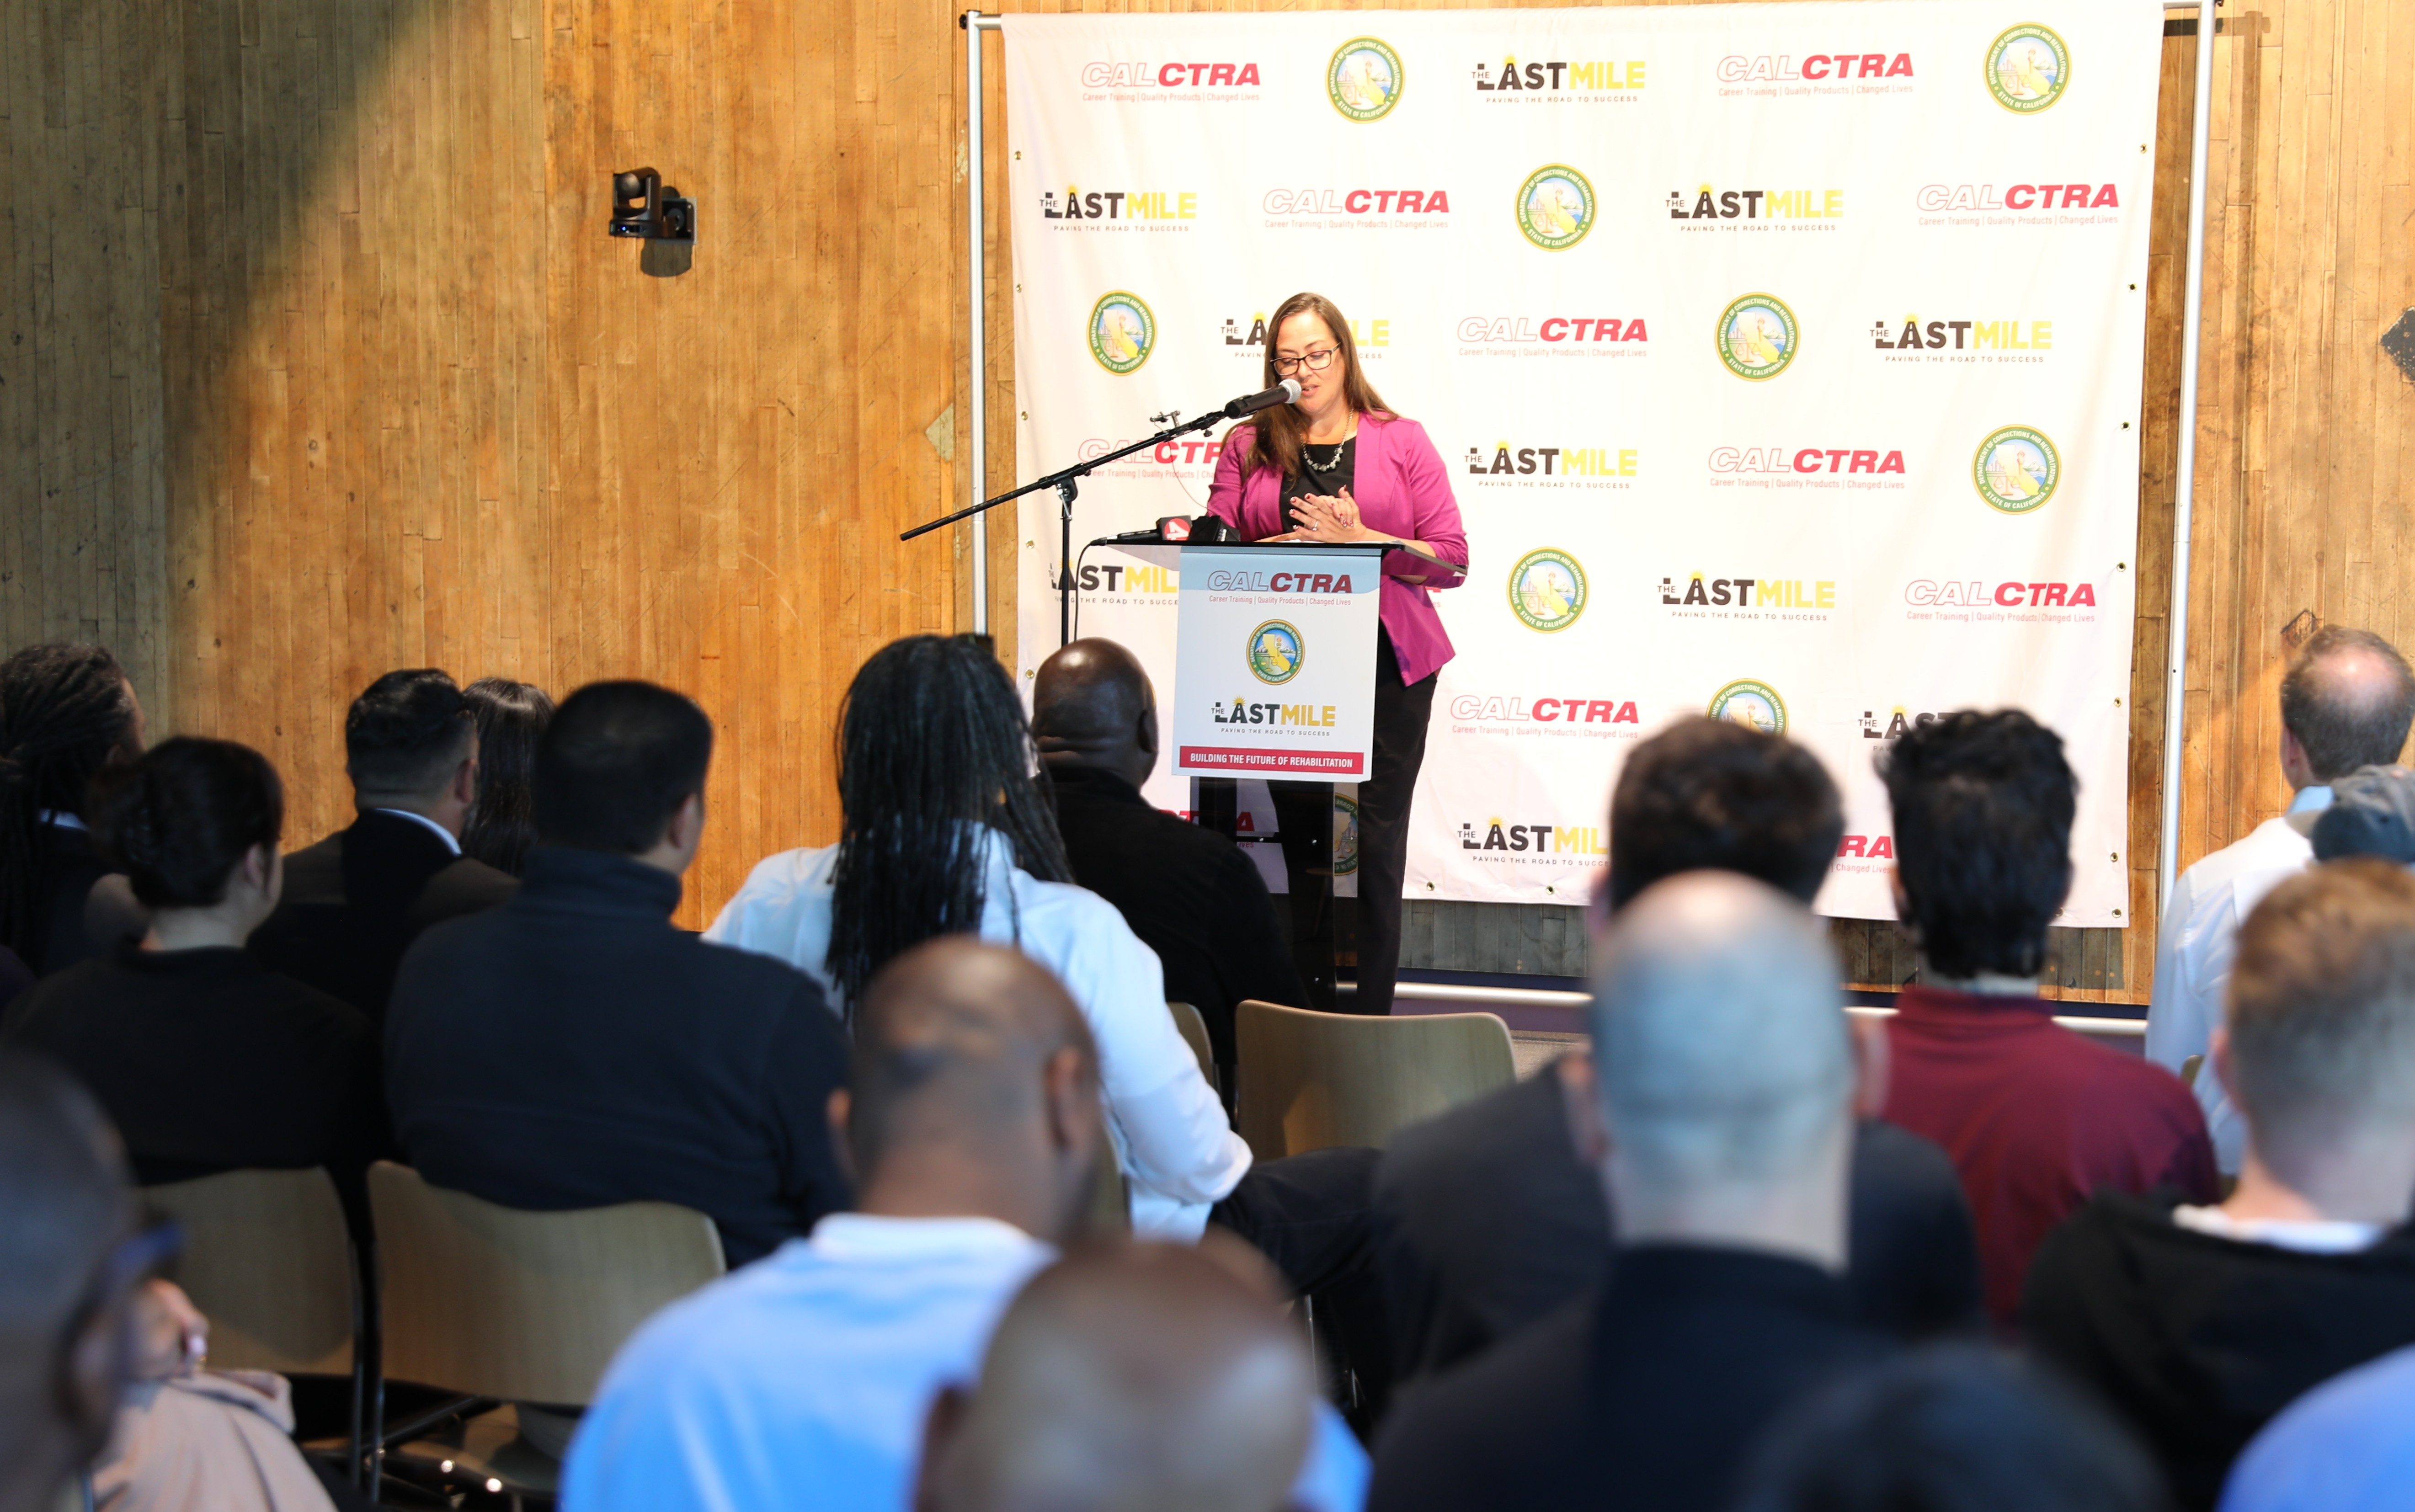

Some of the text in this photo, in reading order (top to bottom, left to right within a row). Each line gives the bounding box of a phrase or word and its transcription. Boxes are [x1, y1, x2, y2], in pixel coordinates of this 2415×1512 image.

[1081, 62, 1261, 87] CALCTRA
[1717, 53, 1914, 82] CALCTRA
[1718, 84, 1913, 98] Career Training Quality Products Changed Lives
[1264, 189, 1450, 214] CALCTRA
[1917, 184, 2119, 211] CALCTRA
[1291, 219, 1322, 229] Training
[1329, 220, 1354, 229] Quality
[1357, 220, 1388, 228] Products
[1395, 220, 1427, 229] Changed
[1919, 215, 2119, 227] Career Training Quality Products Changed Lives
[1458, 317, 1648, 342] CALCTRA
[1486, 347, 1516, 358] Training
[1523, 348, 1549, 357] Quality
[1552, 348, 1585, 356] Products
[1592, 349, 1626, 358] Changed
[1709, 447, 1906, 474] CALCTRA
[1977, 431, 2056, 485] DEPARTMENT OF CORRECTIONS AND REHABILITATION
[1108, 469, 1136, 479] Training
[1142, 470, 1163, 479] Quality
[1710, 478, 1735, 486] Career
[1738, 479, 1770, 489] Training
[1776, 479, 1803, 489] Quality
[1806, 479, 1839, 488] Products
[1847, 480, 1882, 490] Changed
[1986, 491, 2002, 506] STATE
[2012, 491, 2046, 509] CALIFORNIA
[1208, 570, 1353, 593] CALCTRA
[1512, 568, 1523, 604] DEPARTMENT
[1526, 553, 1561, 564] CORRECTIONS
[1560, 556, 1571, 565] AND
[1569, 564, 1584, 605] REHABILITATION
[1229, 596, 1253, 604] Training
[1258, 596, 1278, 605] Quality
[1309, 598, 1334, 606] Changed
[1905, 580, 2096, 607] CALCTRA
[1520, 611, 1535, 624] STATE
[1544, 612, 1574, 628] CALIFORNIA
[1907, 611, 1933, 620] Career
[1935, 612, 1969, 622] Training
[1977, 612, 2005, 622] Quality
[2008, 613, 2037, 622] Products
[2041, 613, 2071, 623] Changed
[1451, 696, 1639, 724] CALCTRA
[1452, 725, 1638, 739] Career Training Quality Products Changed Lives
[1190, 753, 1353, 768] BUILDING THE FUTURE OF REHABILITATION
[1836, 863, 1870, 873] Changed
